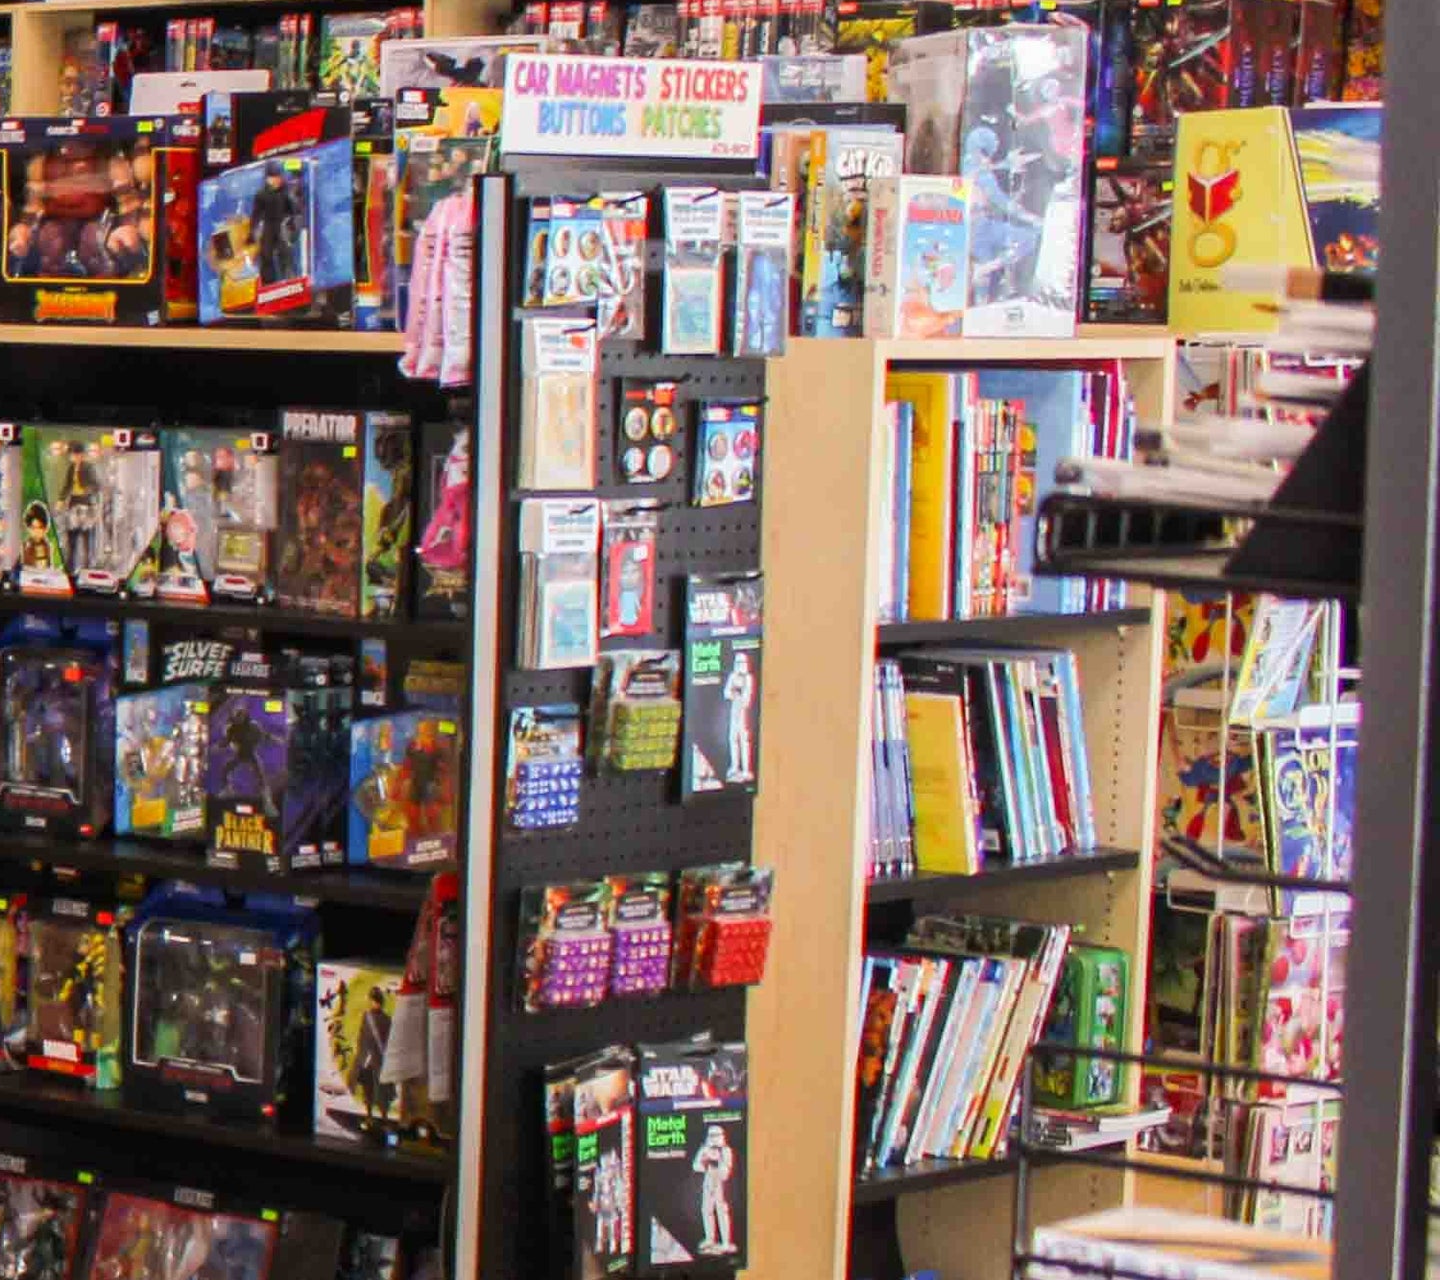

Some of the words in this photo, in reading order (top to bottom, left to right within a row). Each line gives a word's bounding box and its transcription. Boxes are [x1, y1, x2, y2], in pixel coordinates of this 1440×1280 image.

[513, 60, 550, 96] CAR
[555, 62, 647, 99] MAGNETS
[660, 66, 749, 102] STICKERS
[537, 101, 627, 136] BUTTONS
[641, 102, 722, 139] PATCHES
[836, 149, 867, 175] CAT
[283, 411, 357, 442] PREDATOR
[164, 660, 226, 682] SURFE
[223, 810, 268, 830] BLACK
[215, 825, 275, 854] PANTHER
[647, 1116, 688, 1134] Metal
[647, 1131, 687, 1147] Earth
